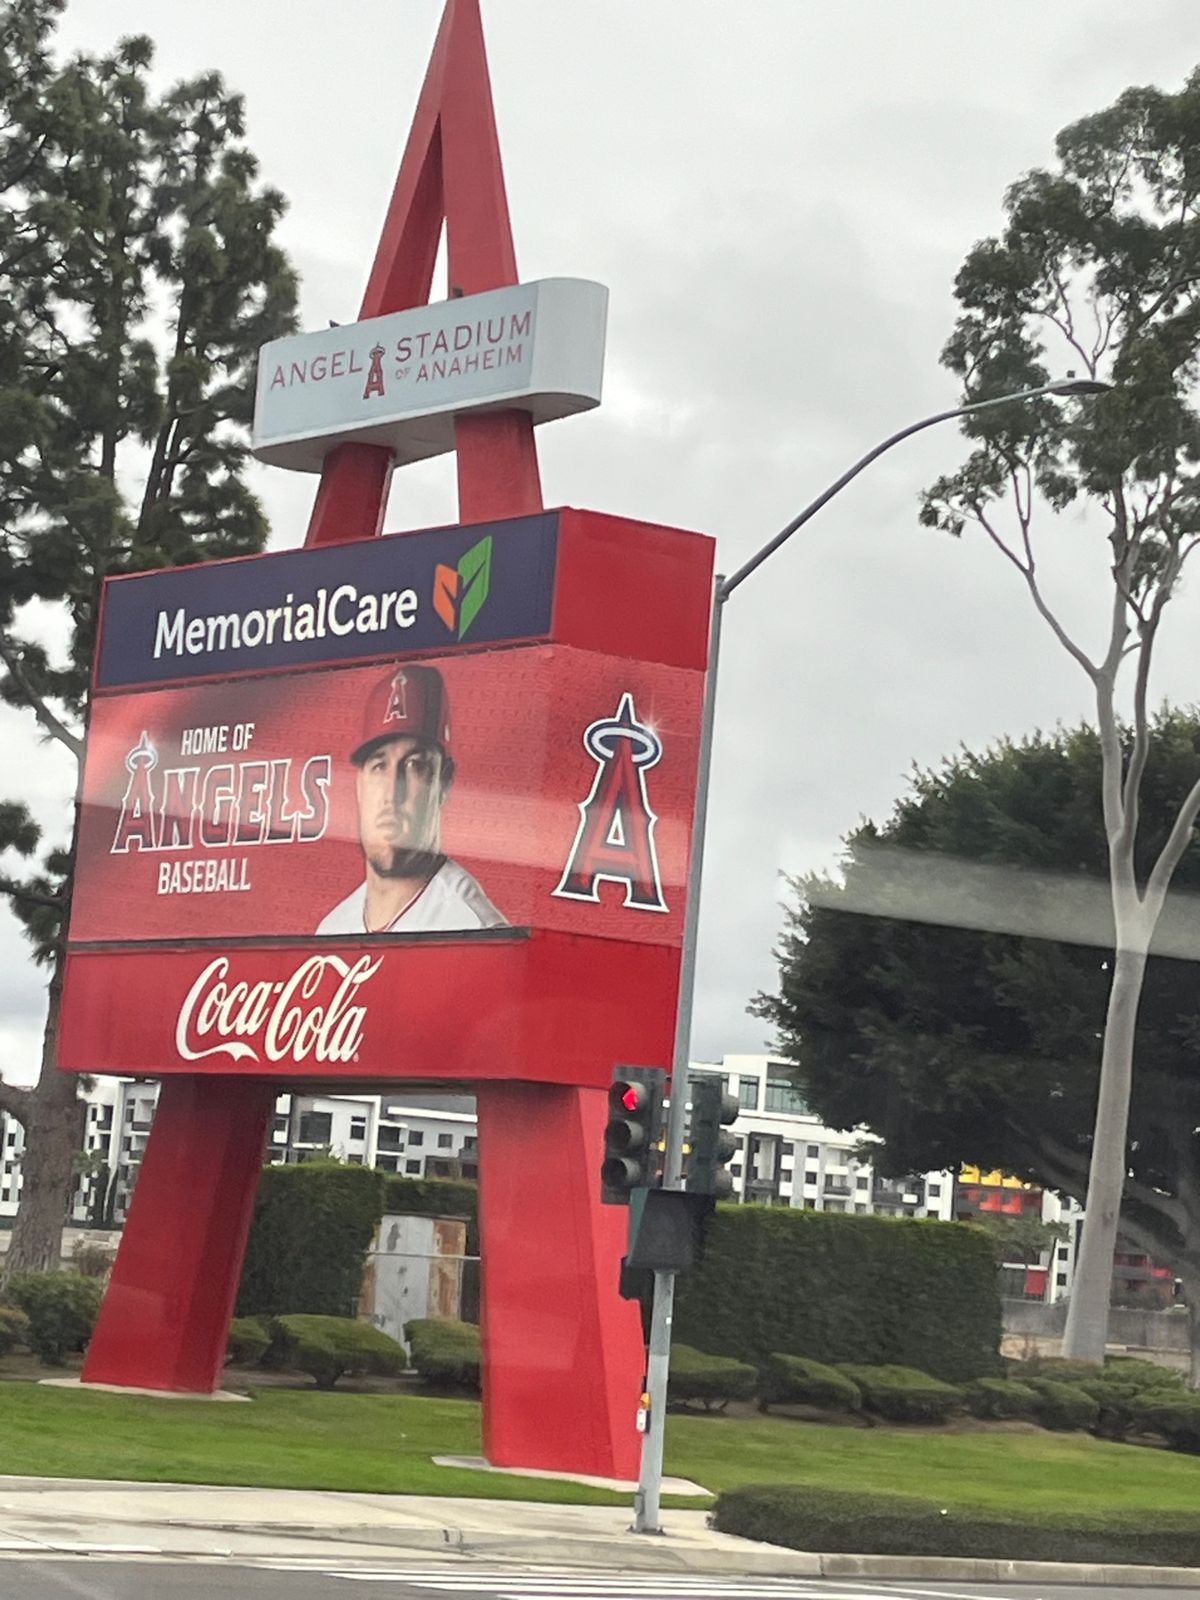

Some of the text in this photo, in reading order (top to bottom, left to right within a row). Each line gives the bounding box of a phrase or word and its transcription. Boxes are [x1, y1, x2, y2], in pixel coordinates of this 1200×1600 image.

[270, 310, 532, 390] ANGEL STADIUM
[416, 343, 523, 383] ANAHEIM
[153, 585, 418, 658] MemorialCare
[180, 723, 255, 756] HOME OF
[110, 731, 332, 854] ANGELS
[550, 692, 670, 913] A
[157, 858, 251, 894] BASEBALL
[175, 954, 385, 1063] Coca-Cola
